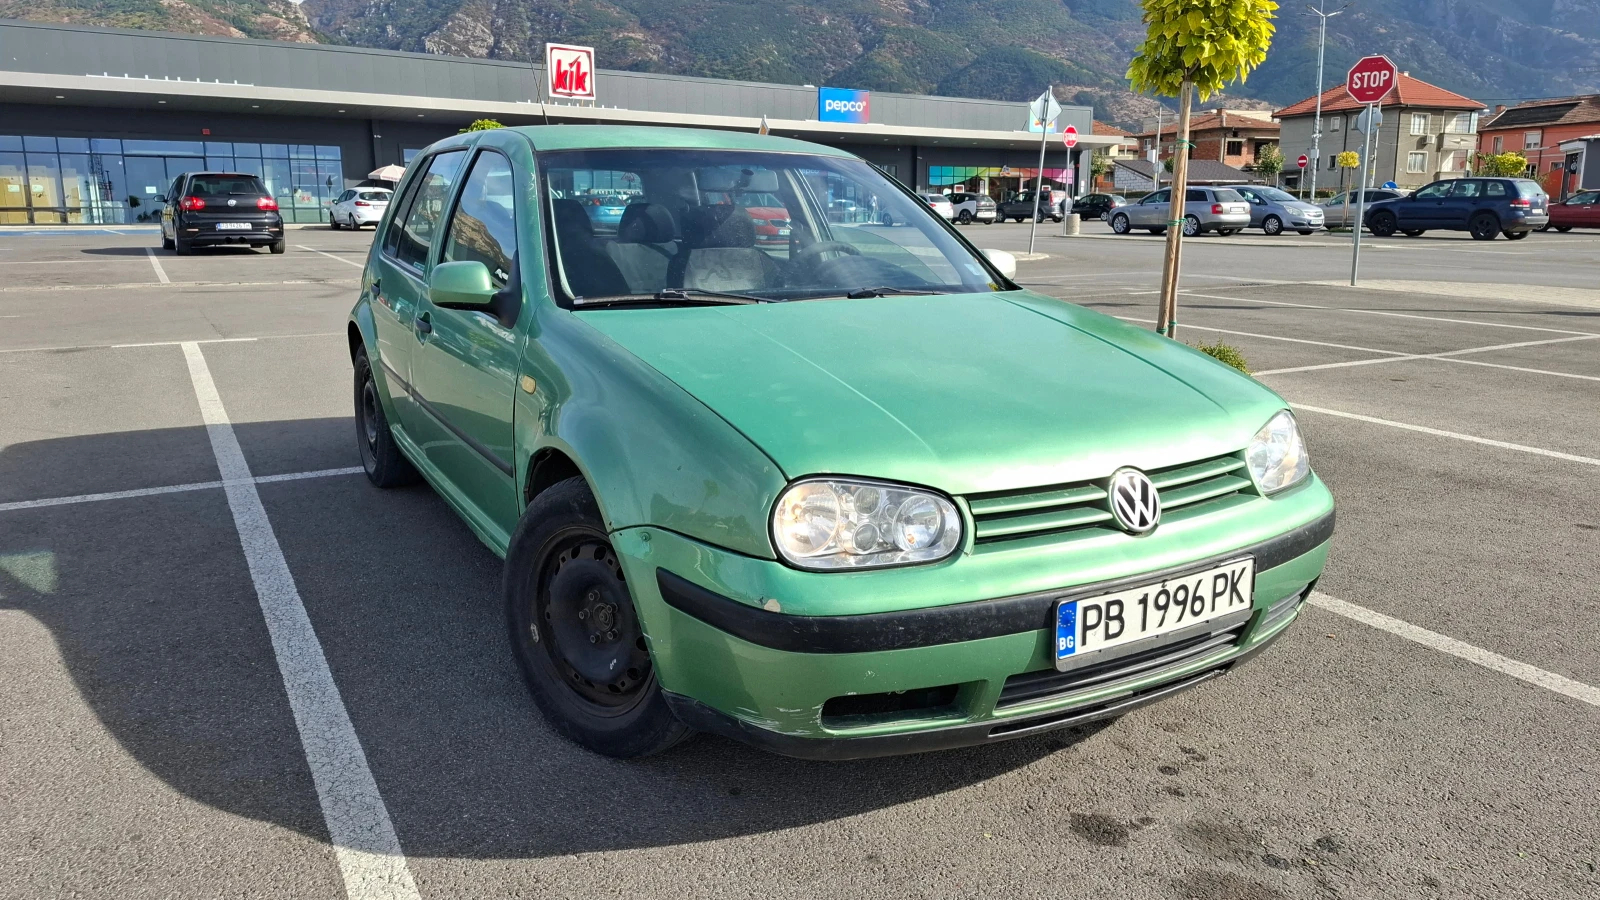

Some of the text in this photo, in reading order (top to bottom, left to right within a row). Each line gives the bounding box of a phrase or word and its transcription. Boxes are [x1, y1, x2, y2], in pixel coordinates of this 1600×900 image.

[555, 55, 588, 92] kik
[1352, 70, 1390, 89] STOP
[825, 99, 864, 113] pepco
[1081, 566, 1247, 647] PB 1996 PK
[1059, 635, 1074, 651] BG
